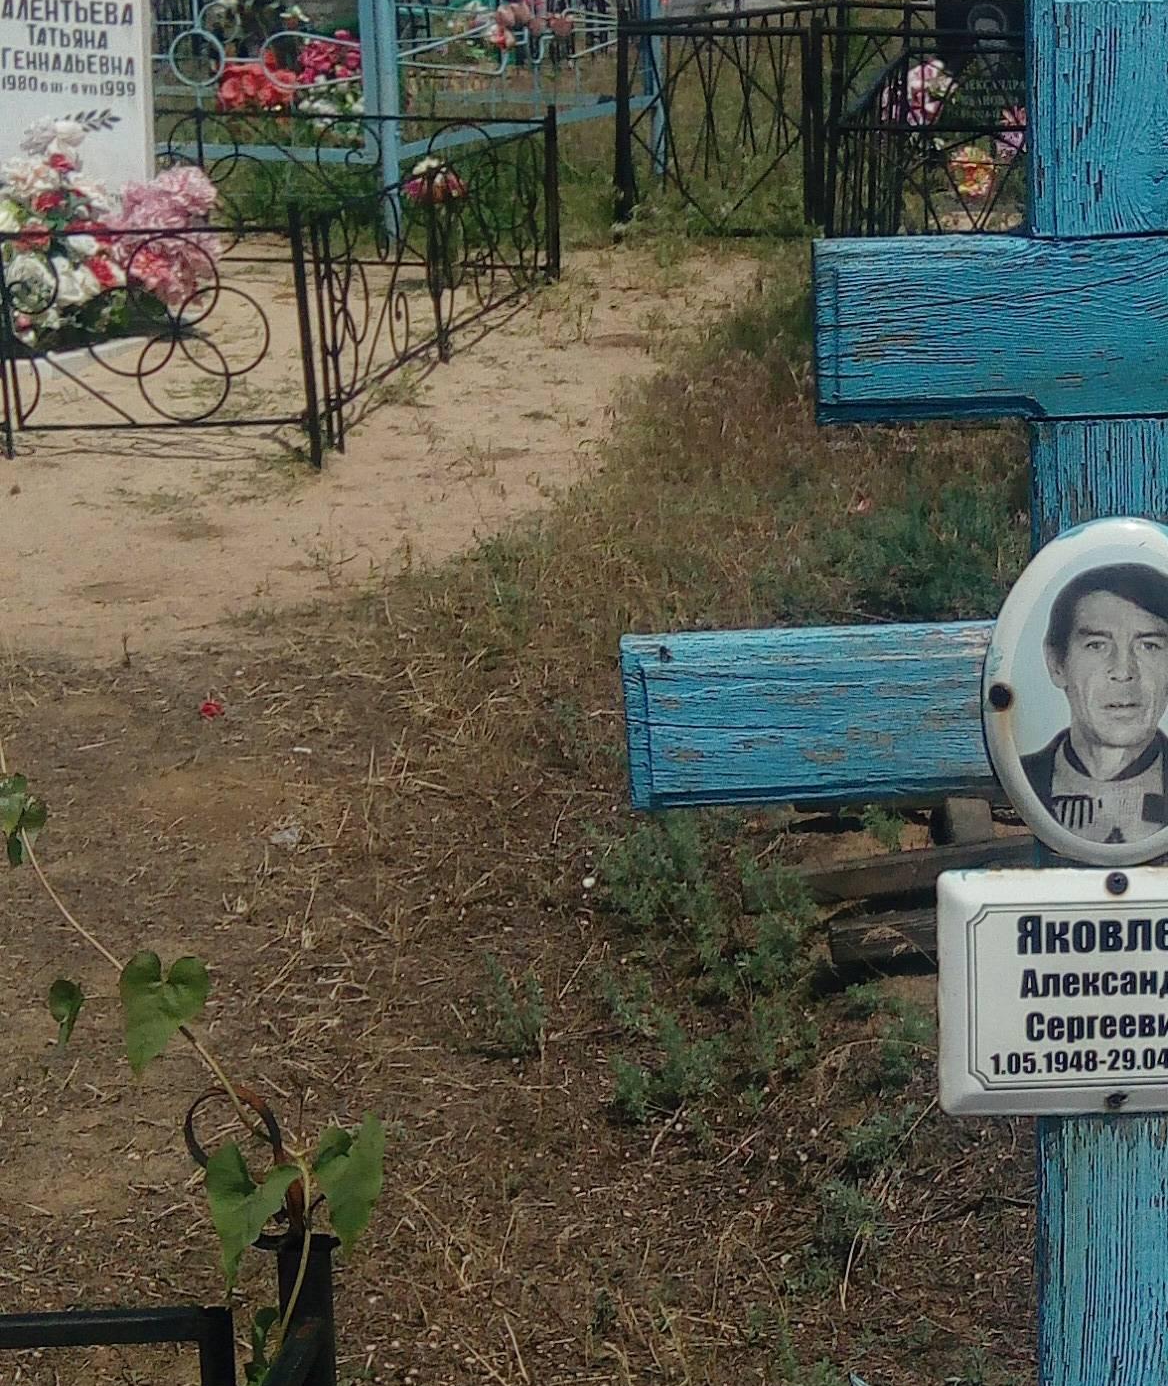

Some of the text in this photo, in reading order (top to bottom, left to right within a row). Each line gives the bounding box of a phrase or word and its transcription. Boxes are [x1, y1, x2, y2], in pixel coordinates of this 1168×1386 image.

[27, 23, 108, 49] ТАТЬЯНА
[2, 75, 38, 91] 1980
[99, 80, 136, 96] 1999
